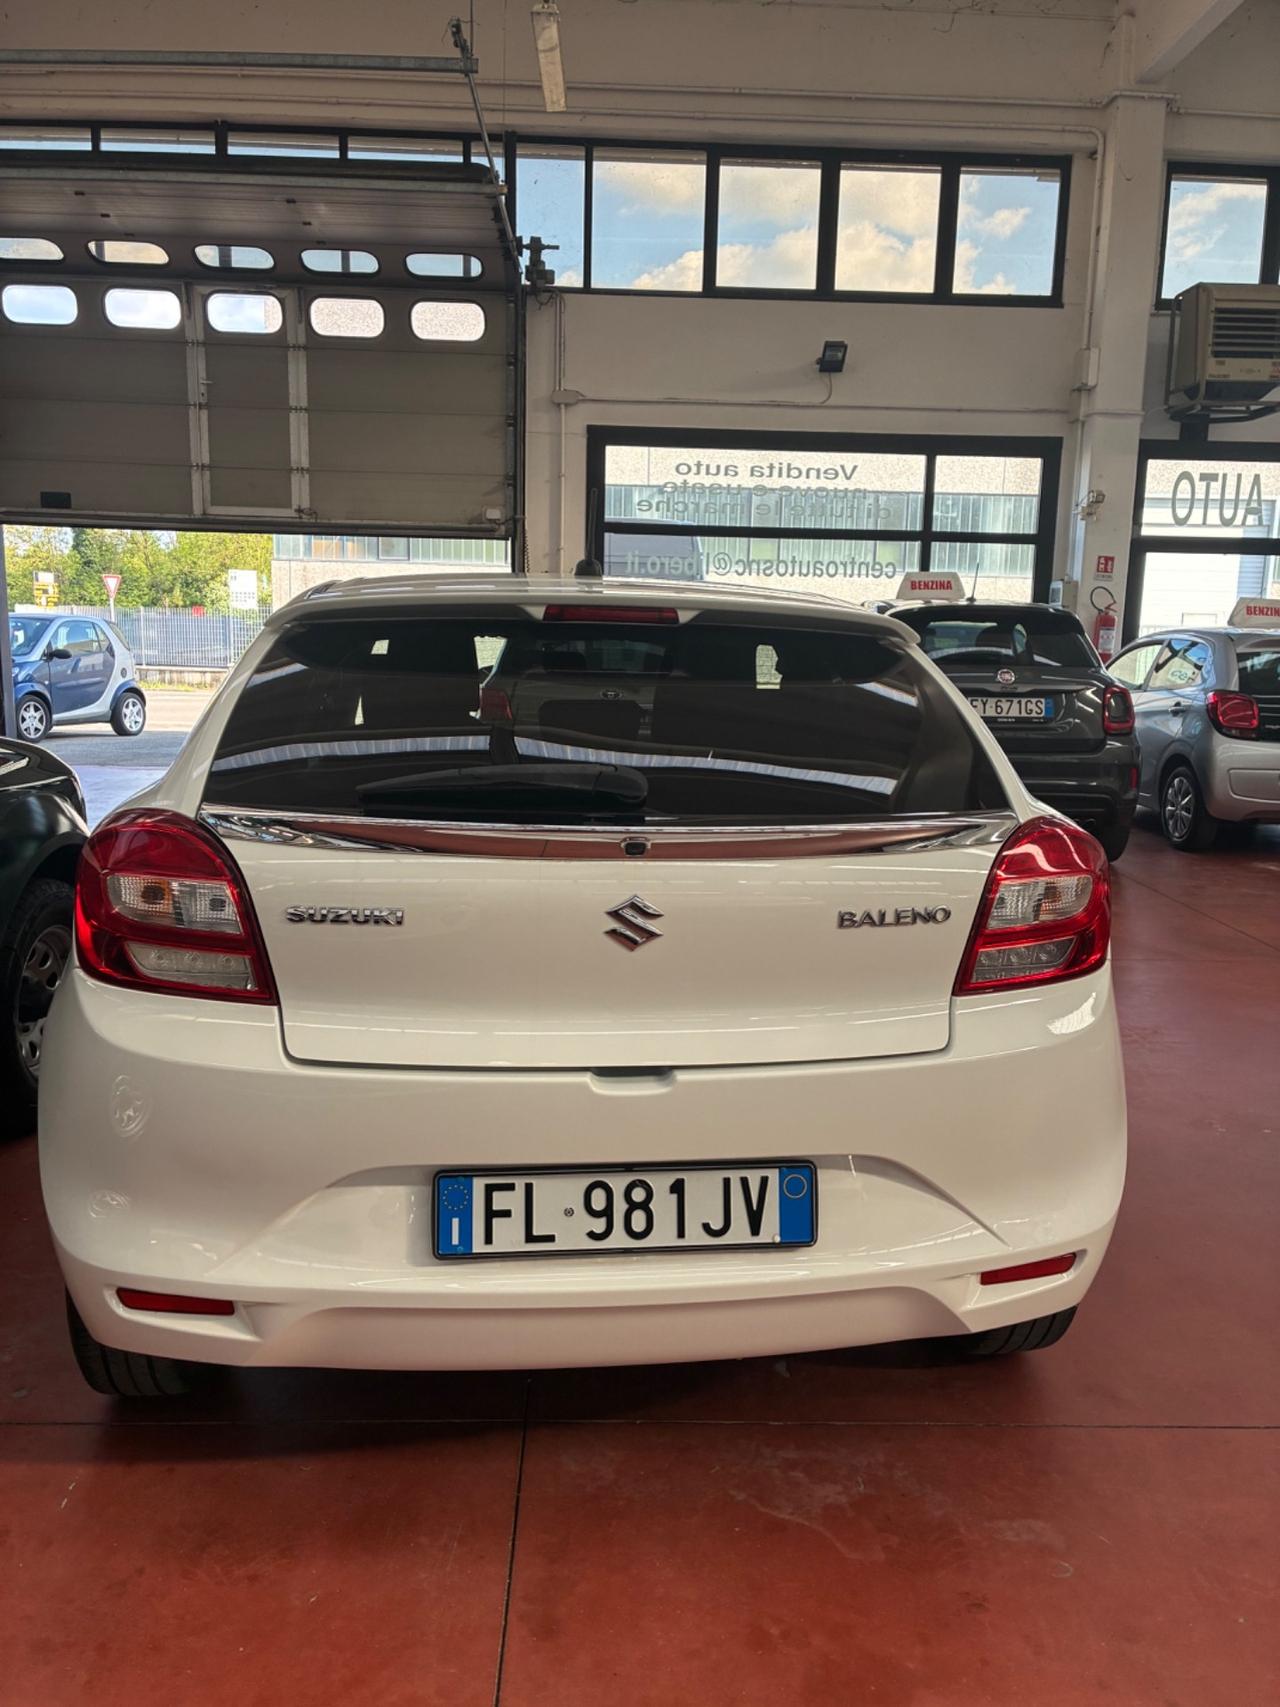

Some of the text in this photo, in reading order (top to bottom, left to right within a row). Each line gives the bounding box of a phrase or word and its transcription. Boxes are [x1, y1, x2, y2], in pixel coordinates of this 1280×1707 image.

[911, 580, 953, 591] BENZINA
[995, 699, 1044, 715] 671GS
[286, 907, 404, 926] SUZUKI
[838, 905, 952, 929] BALENO
[484, 1175, 770, 1246] FL 981JV
